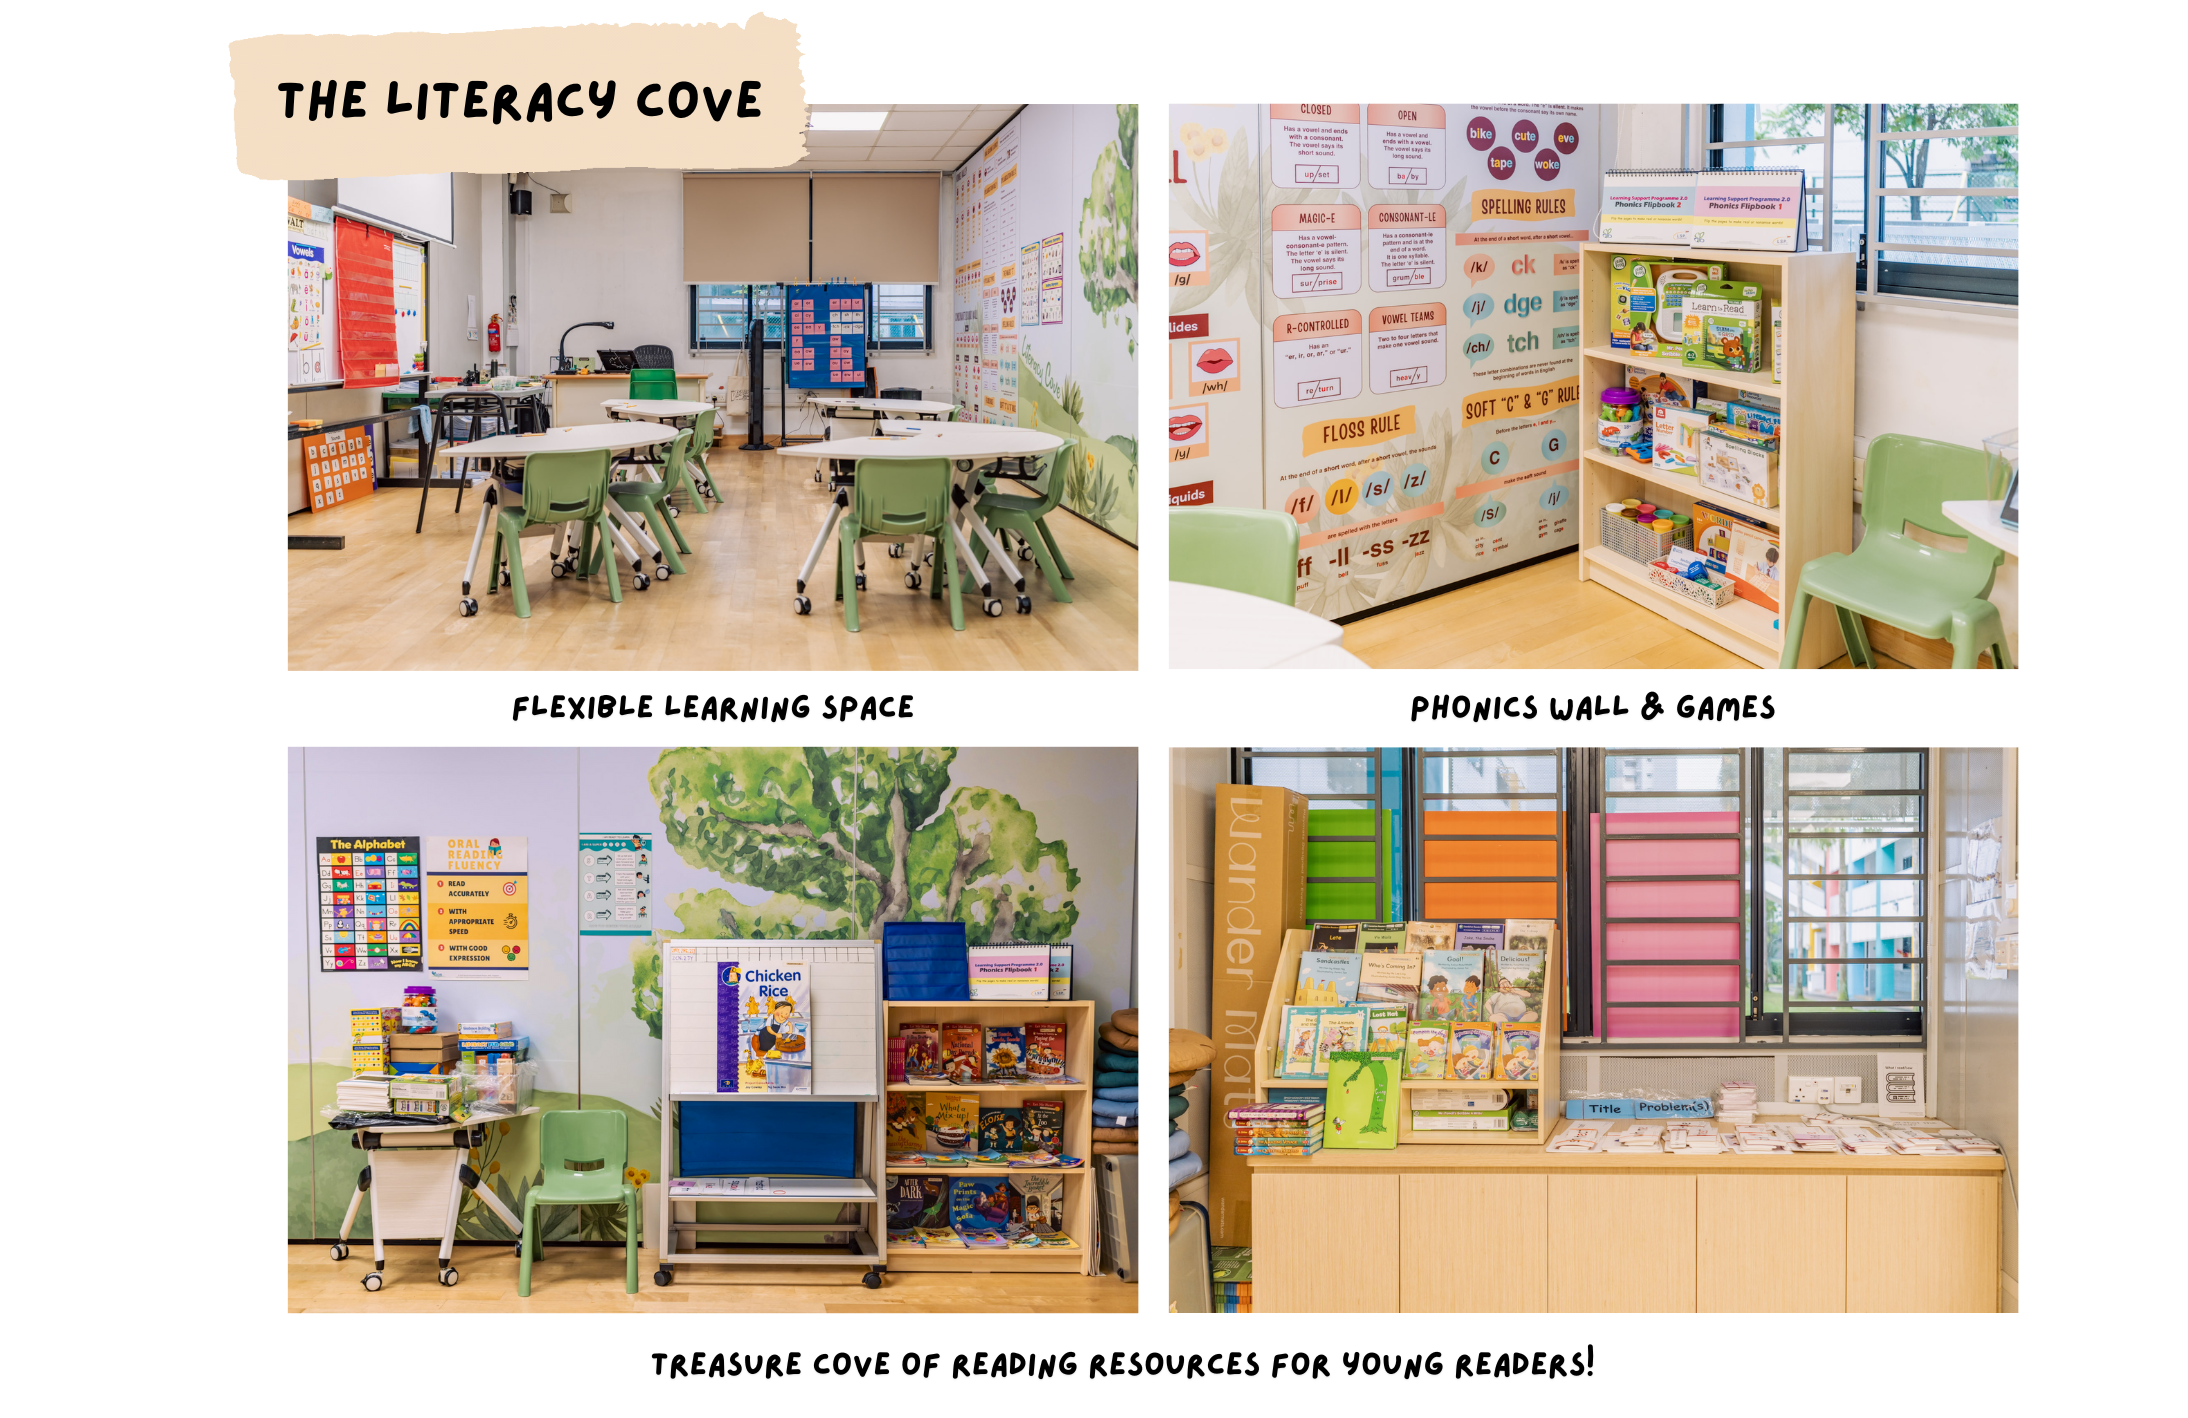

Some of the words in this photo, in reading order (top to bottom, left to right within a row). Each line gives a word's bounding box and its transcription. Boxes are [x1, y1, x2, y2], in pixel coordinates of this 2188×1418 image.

[1301, 104, 1332, 116] CLOSED
[1398, 110, 1417, 121] OPEN
[1470, 128, 1492, 139] bike
[1514, 132, 1536, 141] cute
[1558, 134, 1574, 143] eve
[1490, 158, 1512, 170] tape
[1535, 160, 1560, 169] woke
[1482, 199, 1531, 214] SPELLING
[1536, 199, 1566, 214] RULES
[1299, 213, 1336, 224] MAGIC-E
[1379, 212, 1436, 222] CONSONANT-LE
[292, 244, 314, 257] Vowels
[1470, 261, 1488, 273] /k/
[1512, 254, 1536, 275] ck
[1174, 273, 1190, 286] /g/
[1471, 300, 1486, 315] /j/
[1504, 293, 1542, 318] dge
[1692, 302, 1717, 312] Learn
[1723, 304, 1744, 313] Read
[1382, 312, 1408, 325] VOWEL
[1410, 310, 1434, 322] TEAMS
[1286, 318, 1350, 334] R-CONTROLLED
[1466, 340, 1490, 354] /ch/
[1507, 331, 1539, 353] tch
[1045, 361, 1061, 399] Cove
[1202, 381, 1228, 394] /wh/
[1466, 399, 1496, 419] SOFT
[1524, 393, 1532, 408] &
[1323, 421, 1365, 443] FLOSS
[1371, 414, 1400, 435] RULE
[1549, 438, 1559, 452] G
[1726, 443, 1746, 453] Spelling
[1748, 450, 1764, 458] Blocks
[1174, 447, 1190, 460] /y/
[1489, 451, 1500, 465] C
[1324, 464, 1340, 473] short
[1341, 461, 1356, 470] word,
[1392, 451, 1408, 459] vowel,
[1404, 470, 1426, 489] /z/
[1366, 478, 1390, 498] /s/
[1331, 486, 1352, 506] /l/
[1548, 491, 1560, 505] /j/
[1290, 495, 1314, 515] /f/
[1481, 507, 1499, 522] /S/
[1402, 530, 1430, 547] -zz
[1362, 539, 1394, 558] -ss
[1329, 547, 1349, 567] -ll
[331, 840, 351, 849] The
[354, 840, 406, 851] Alphabet
[448, 839, 479, 848] ORAL
[448, 850, 503, 859] READING
[448, 861, 501, 870] FLUENCY
[1226, 797, 1263, 990] Wander
[745, 969, 801, 982] Chicken
[760, 985, 788, 997] Rice
[940, 1103, 960, 1113] What
[1589, 1104, 1621, 1114] Title
[1640, 1101, 1710, 1112] Problem(s)
[937, 1112, 969, 1122] Mix-up!
[980, 1114, 1005, 1131] ELOISE
[900, 1186, 923, 1199] DARK
[952, 1204, 973, 1212] Magic
[956, 1213, 973, 1222] Sofa
